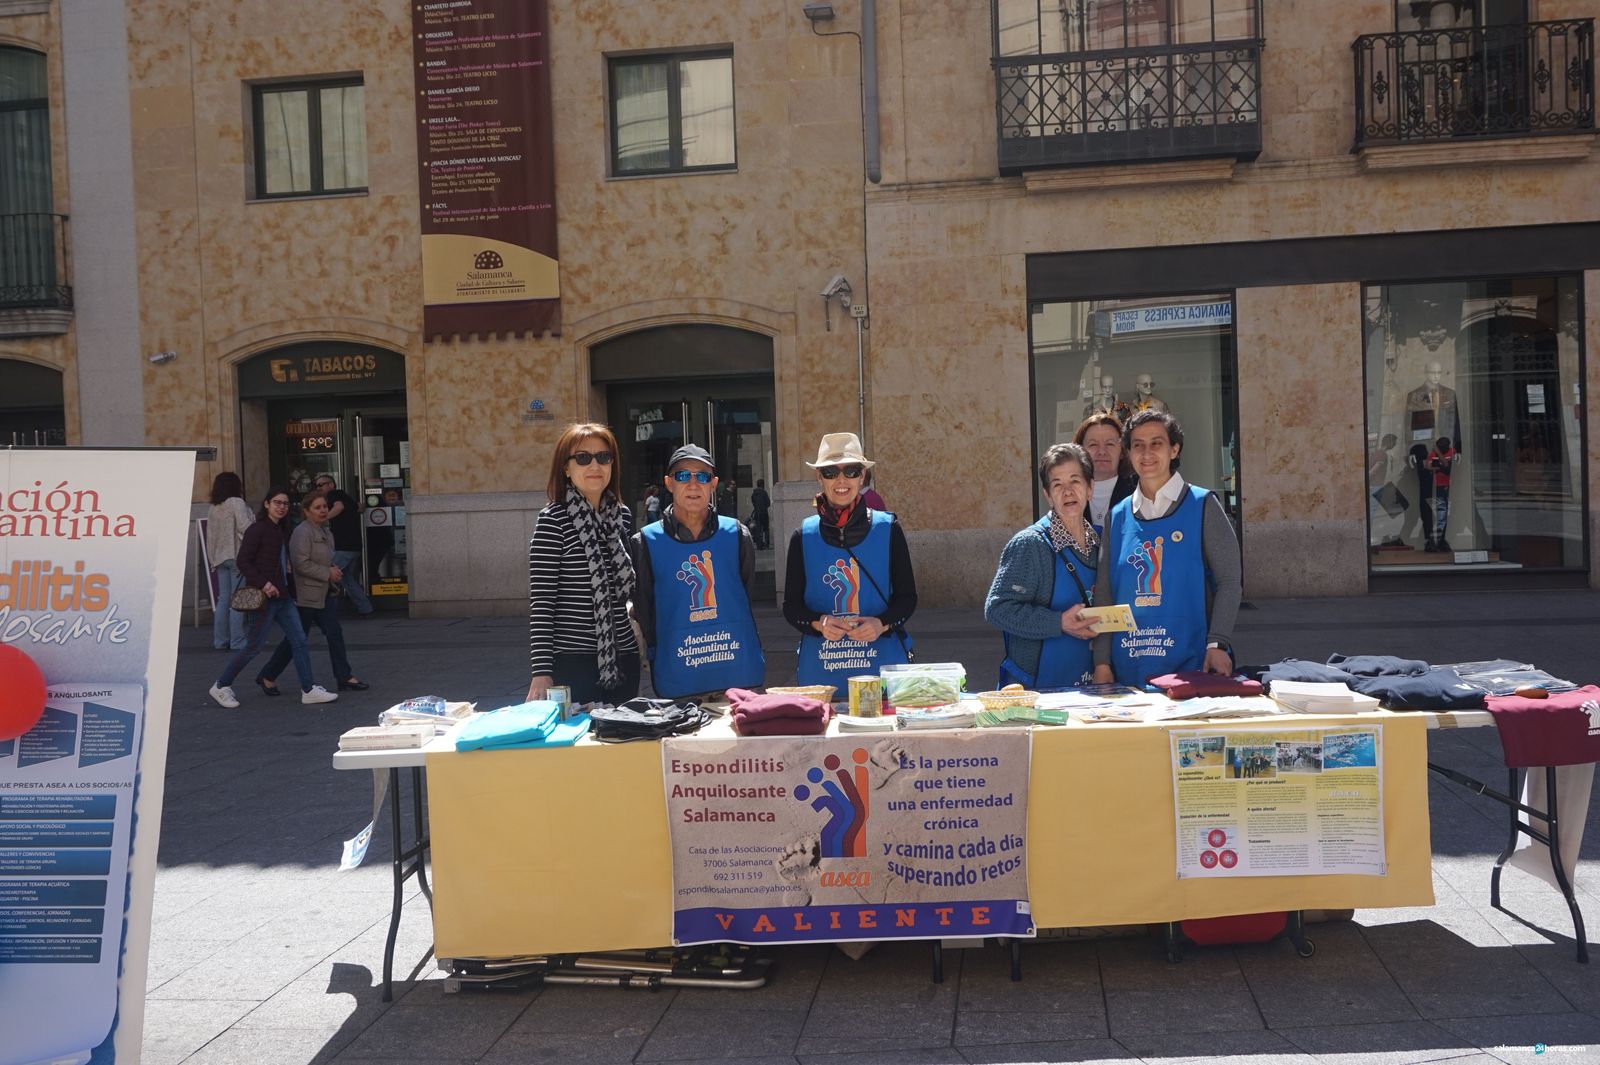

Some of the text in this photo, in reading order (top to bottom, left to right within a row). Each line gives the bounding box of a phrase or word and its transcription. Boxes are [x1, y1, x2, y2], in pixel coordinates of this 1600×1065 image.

[430, 159, 448, 167] ¿HACIA
[450, 157, 466, 165] DÓNDE
[466, 270, 512, 280] Salamanca
[304, 354, 376, 373] TABACOS
[0, 481, 101, 513] ción
[684, 630, 730, 646] Asociación
[1164, 638, 1174, 646] de
[678, 641, 740, 657] Salmantina de
[818, 648, 877, 660] Salmantina de
[686, 652, 734, 668] Espondilitis
[824, 659, 871, 672] Espondilitis
[54, 690, 112, 698] ANQUILOSANTE
[672, 758, 784, 776] Espondilitis
[900, 756, 998, 771] Es la persona
[914, 776, 986, 792] que tiene
[672, 784, 786, 800] Anquilosante
[888, 794, 1012, 810] una enfermedad
[684, 808, 776, 822] Salamanca
[924, 817, 978, 830] crónica
[688, 845, 786, 854] Casa de las Asociaciones
[883, 834, 1023, 860] y camina cada día
[704, 858, 772, 868] 37006 Salamanca
[714, 872, 762, 881] 692 311 519
[888, 855, 1021, 887] superando retos
[820, 870, 872, 888] asea
[678, 884, 802, 896] espondilosalamanca@yahoo.es
[715, 907, 990, 932] VALIENTE
